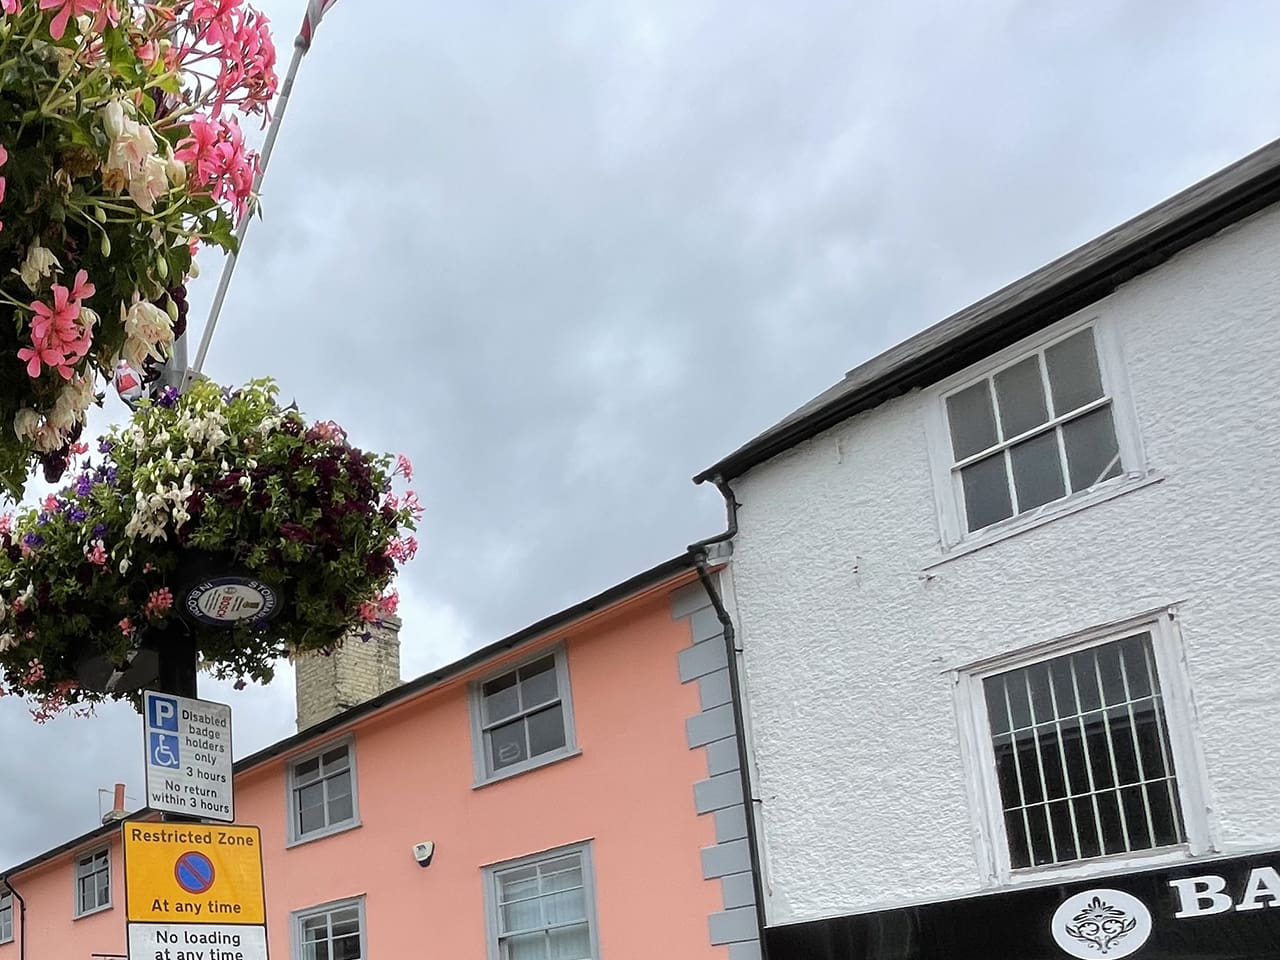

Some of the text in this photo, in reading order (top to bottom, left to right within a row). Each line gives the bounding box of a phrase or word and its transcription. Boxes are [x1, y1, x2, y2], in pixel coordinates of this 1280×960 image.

[188, 590, 203, 617] BLOOM
[215, 595, 232, 618] BOSCH
[156, 700, 174, 726] P
[182, 710, 227, 728] Disabled
[189, 725, 221, 740] badge
[186, 737, 225, 752] holders
[195, 753, 217, 766] only
[186, 766, 226, 783] 3 hours
[165, 780, 217, 798] No return
[152, 792, 230, 813] within 3 hours
[132, 829, 254, 846] Restricted Zone
[1169, 867, 1280, 918] BA
[152, 899, 241, 915] At any time
[156, 931, 241, 947] No loading
[155, 949, 170, 960] at
[210, 949, 243, 960] time
